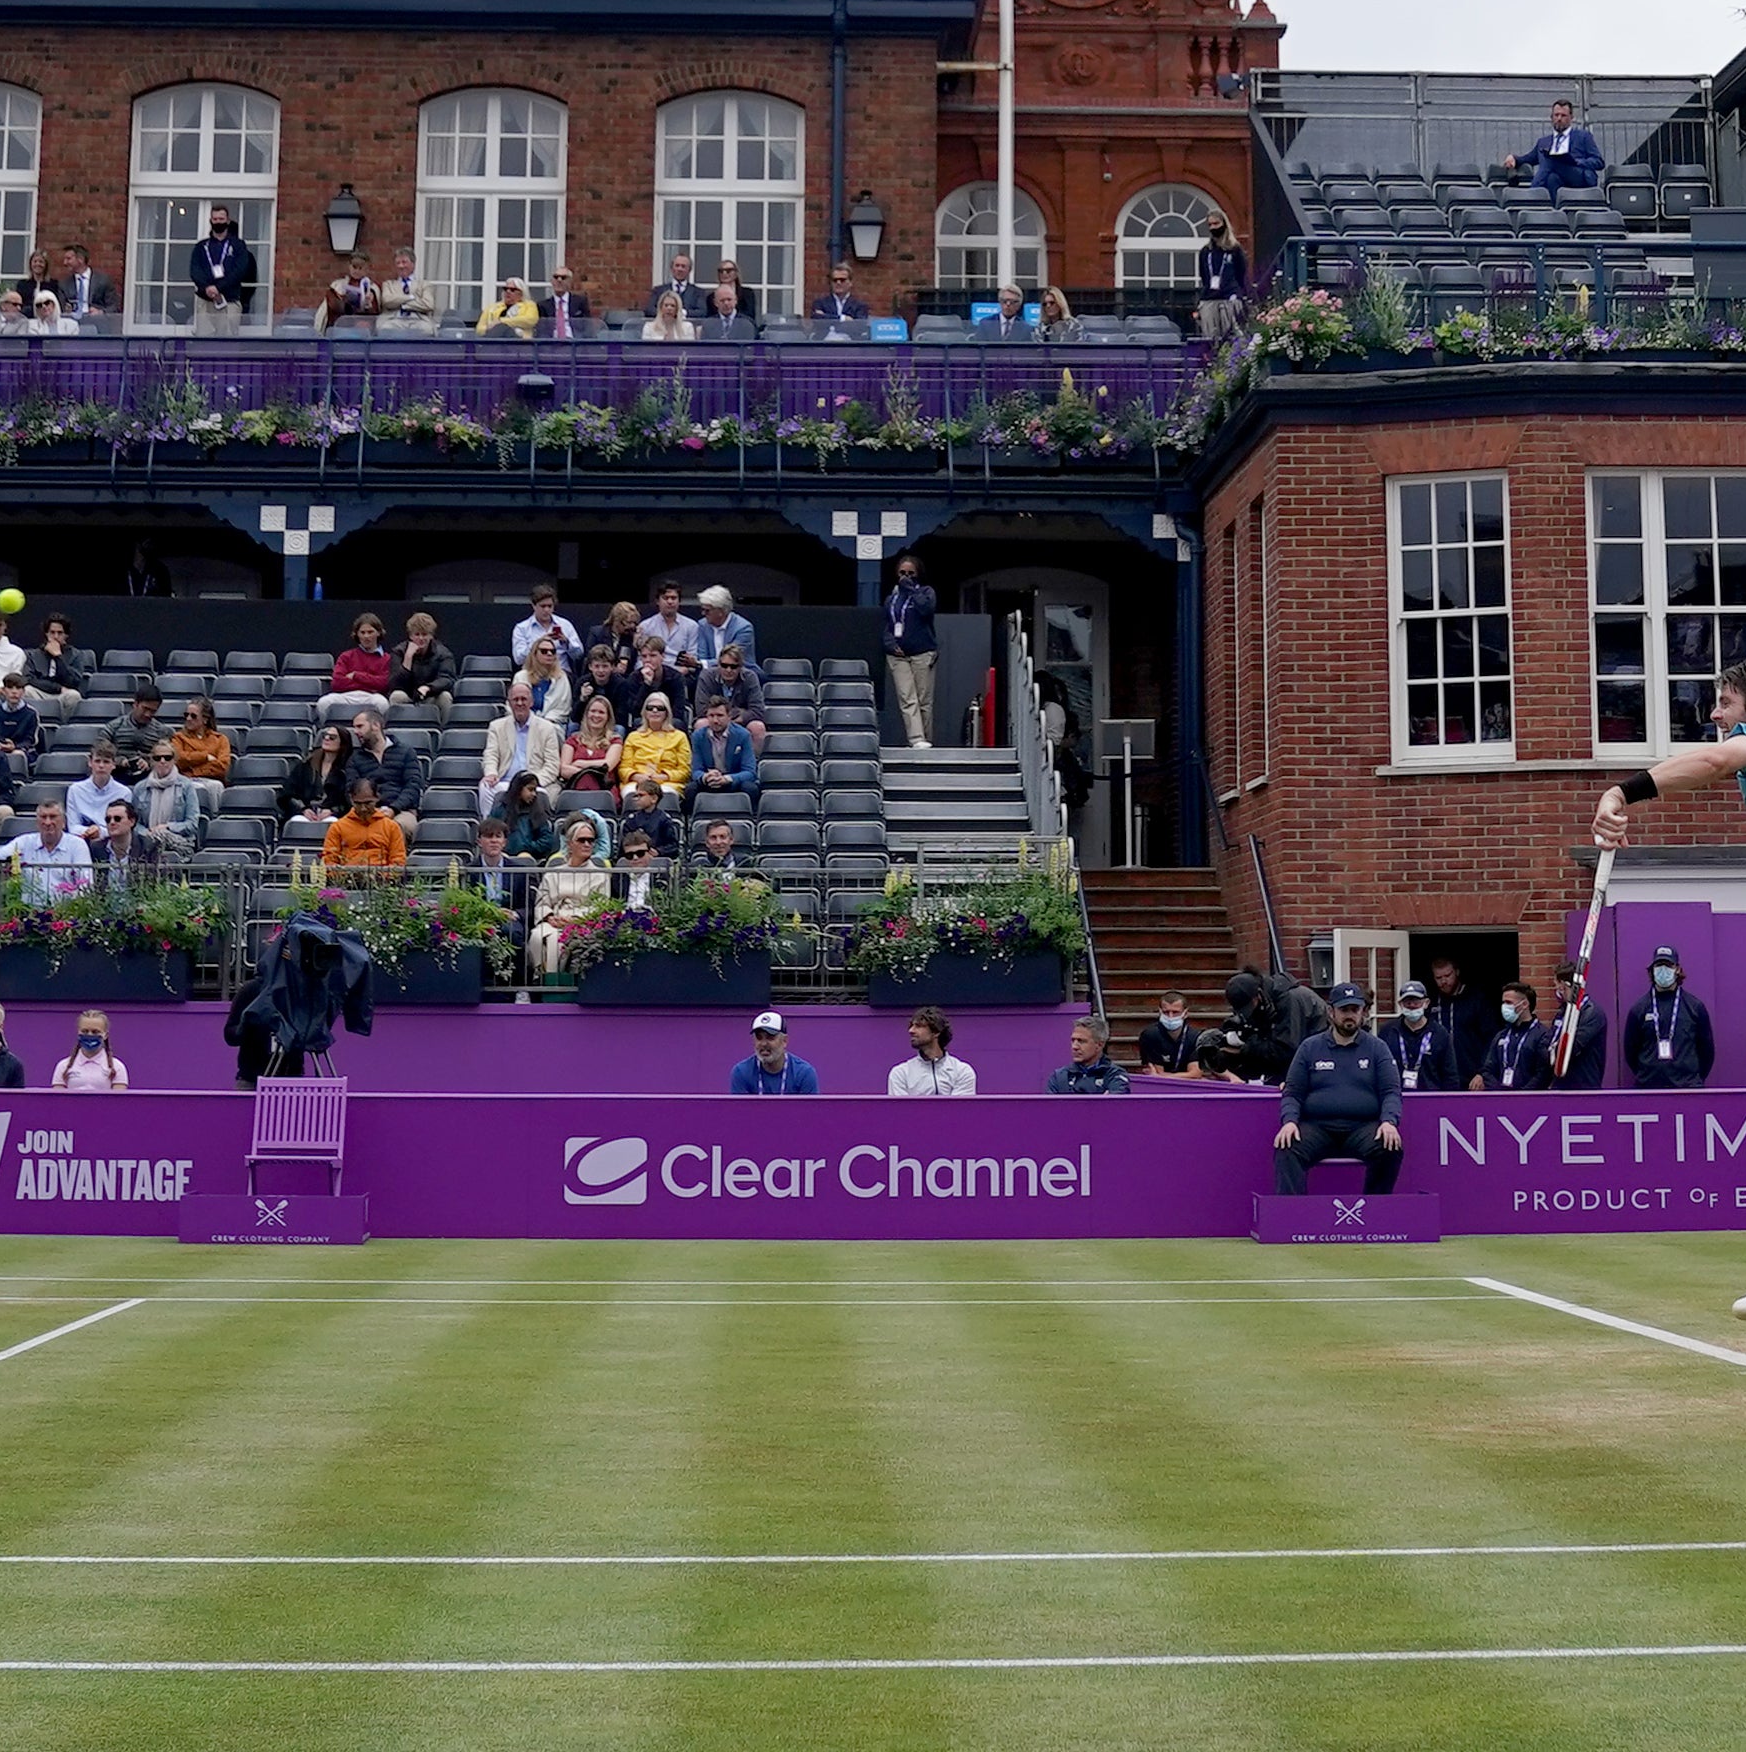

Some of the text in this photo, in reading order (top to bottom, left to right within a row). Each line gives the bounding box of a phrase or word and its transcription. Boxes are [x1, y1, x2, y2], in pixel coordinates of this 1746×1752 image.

[17, 1130, 74, 1154] JOIN
[16, 1159, 193, 1201] ADVANTAGE
[661, 1144, 1091, 1199] Clear Channel
[1514, 1187, 1672, 1212] PRODUCT
[211, 1234, 236, 1242] CREW
[239, 1235, 284, 1243] CLOTHING
[1292, 1234, 1316, 1242] CREW
